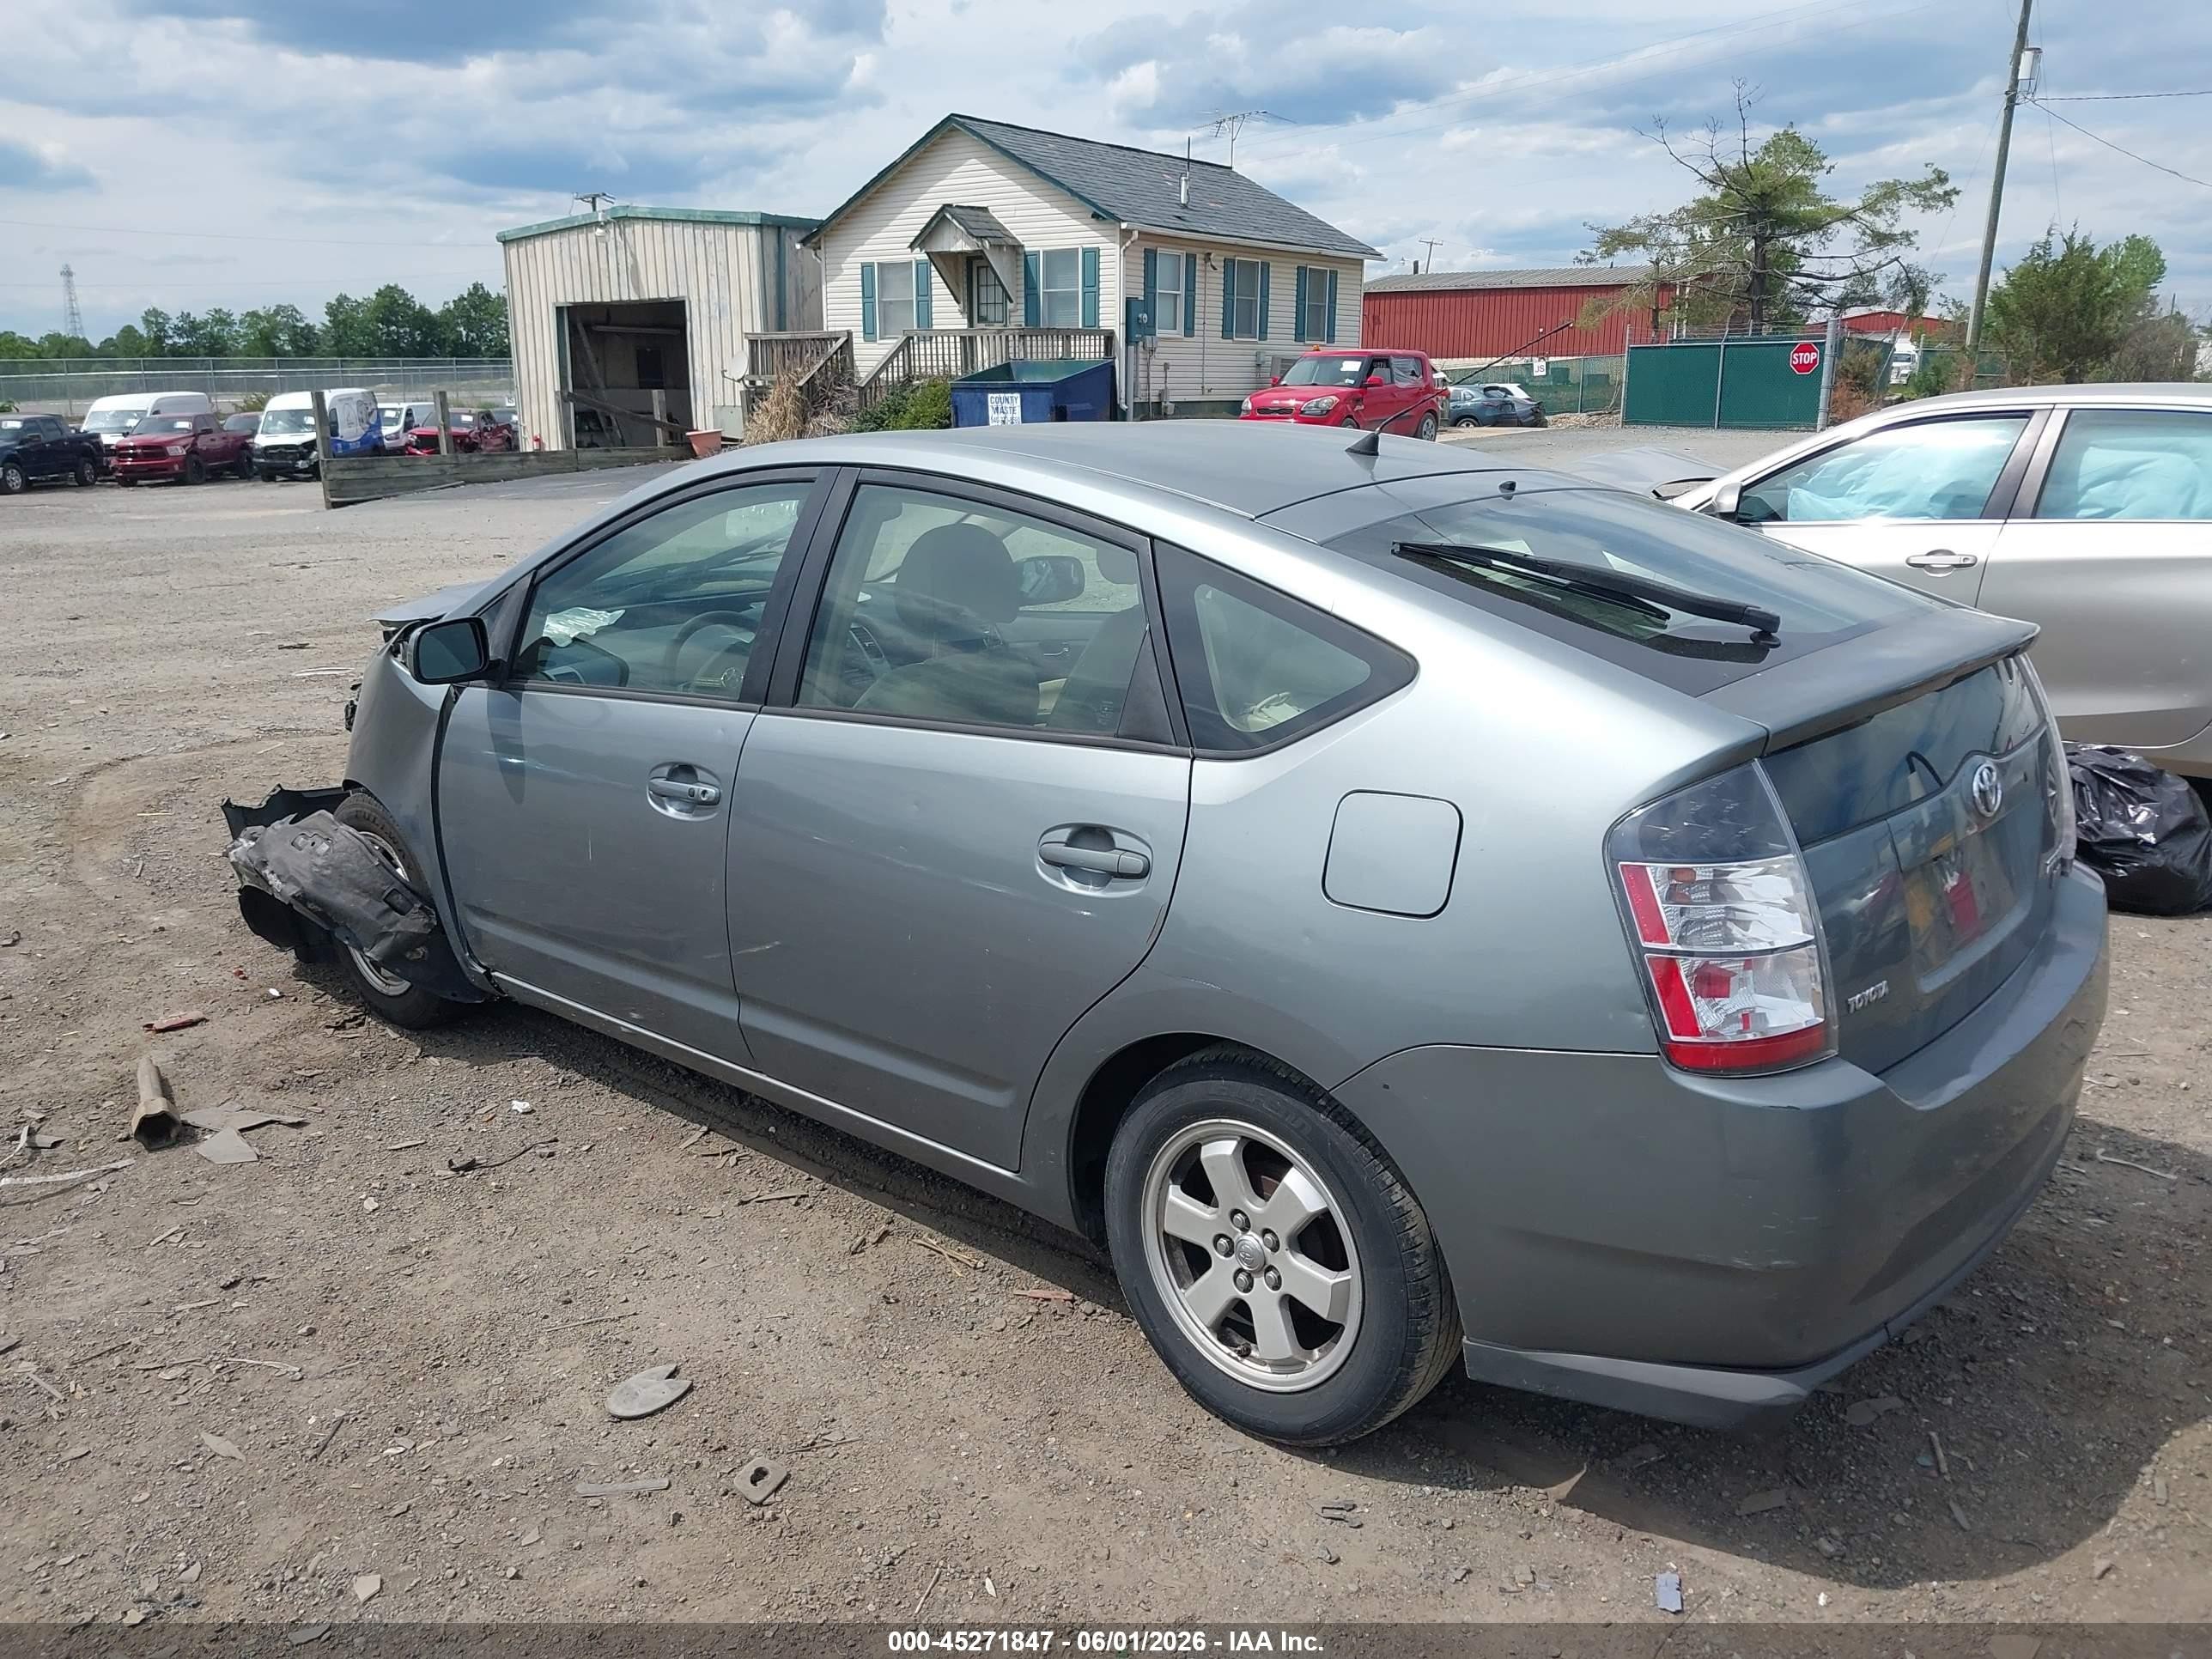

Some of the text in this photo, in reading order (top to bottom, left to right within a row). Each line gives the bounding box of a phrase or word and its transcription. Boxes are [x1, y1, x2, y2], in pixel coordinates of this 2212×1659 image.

[1792, 352, 1817, 365] STOP
[990, 396, 1018, 404] COUNTY
[990, 405, 1018, 415] WASTE
[1847, 980, 1888, 1014] TOYOTA
